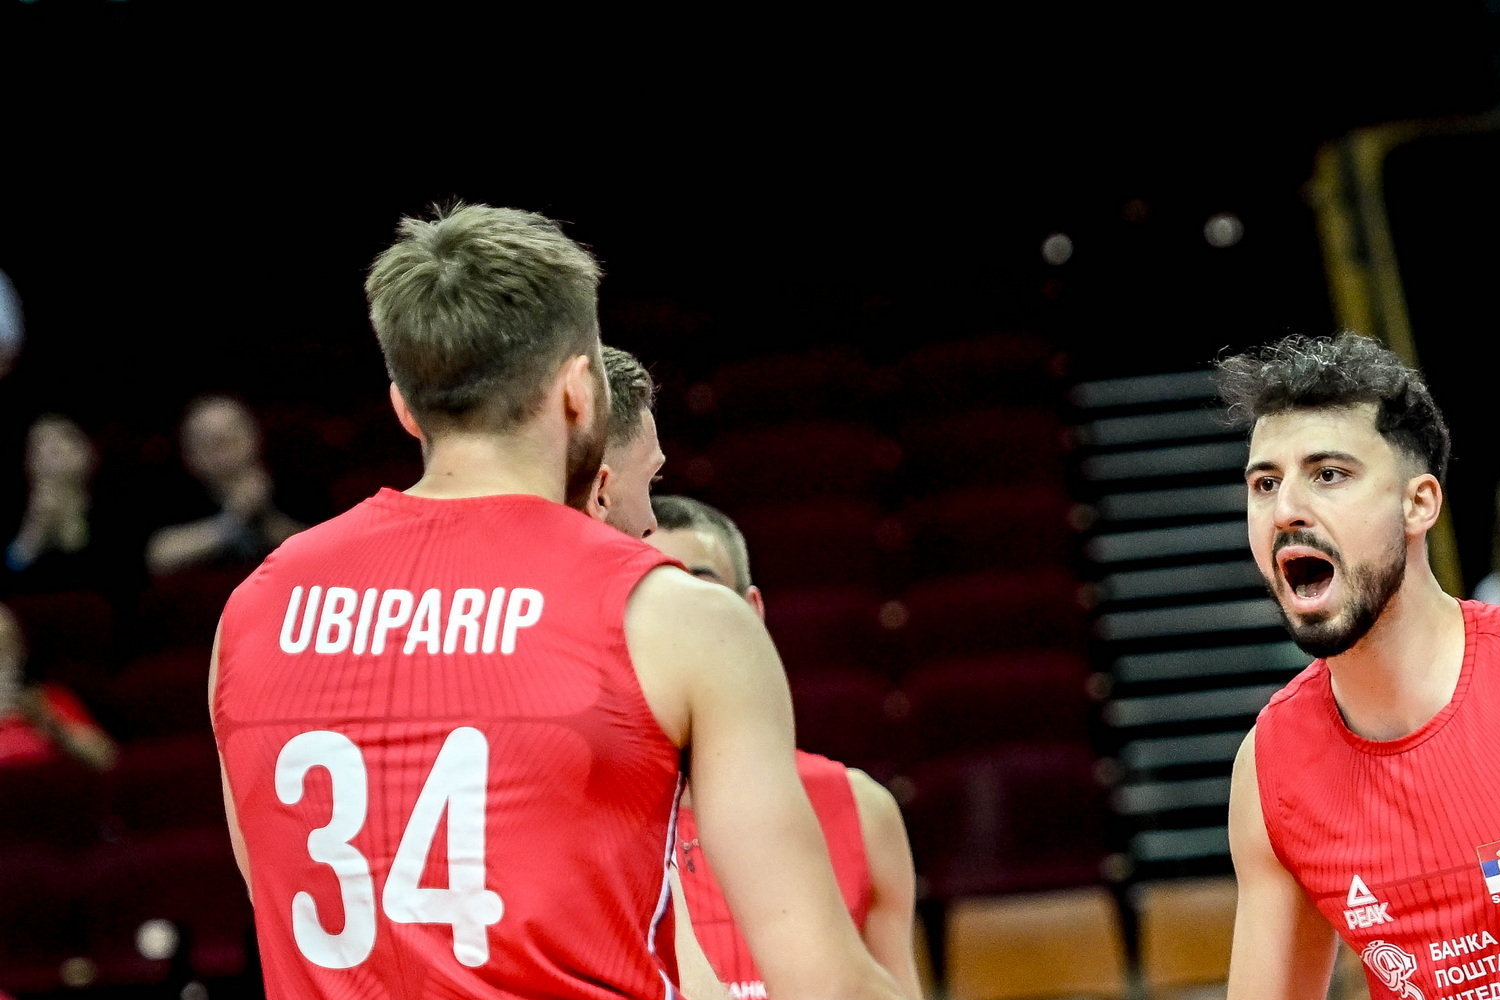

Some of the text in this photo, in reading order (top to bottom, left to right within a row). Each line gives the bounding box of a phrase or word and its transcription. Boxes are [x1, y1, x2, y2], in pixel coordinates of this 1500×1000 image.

[279, 585, 544, 655] UBIPARIP
[274, 726, 504, 970] 34
[1343, 902, 1394, 930] PEAK
[1429, 930, 1498, 961] БАНКА
